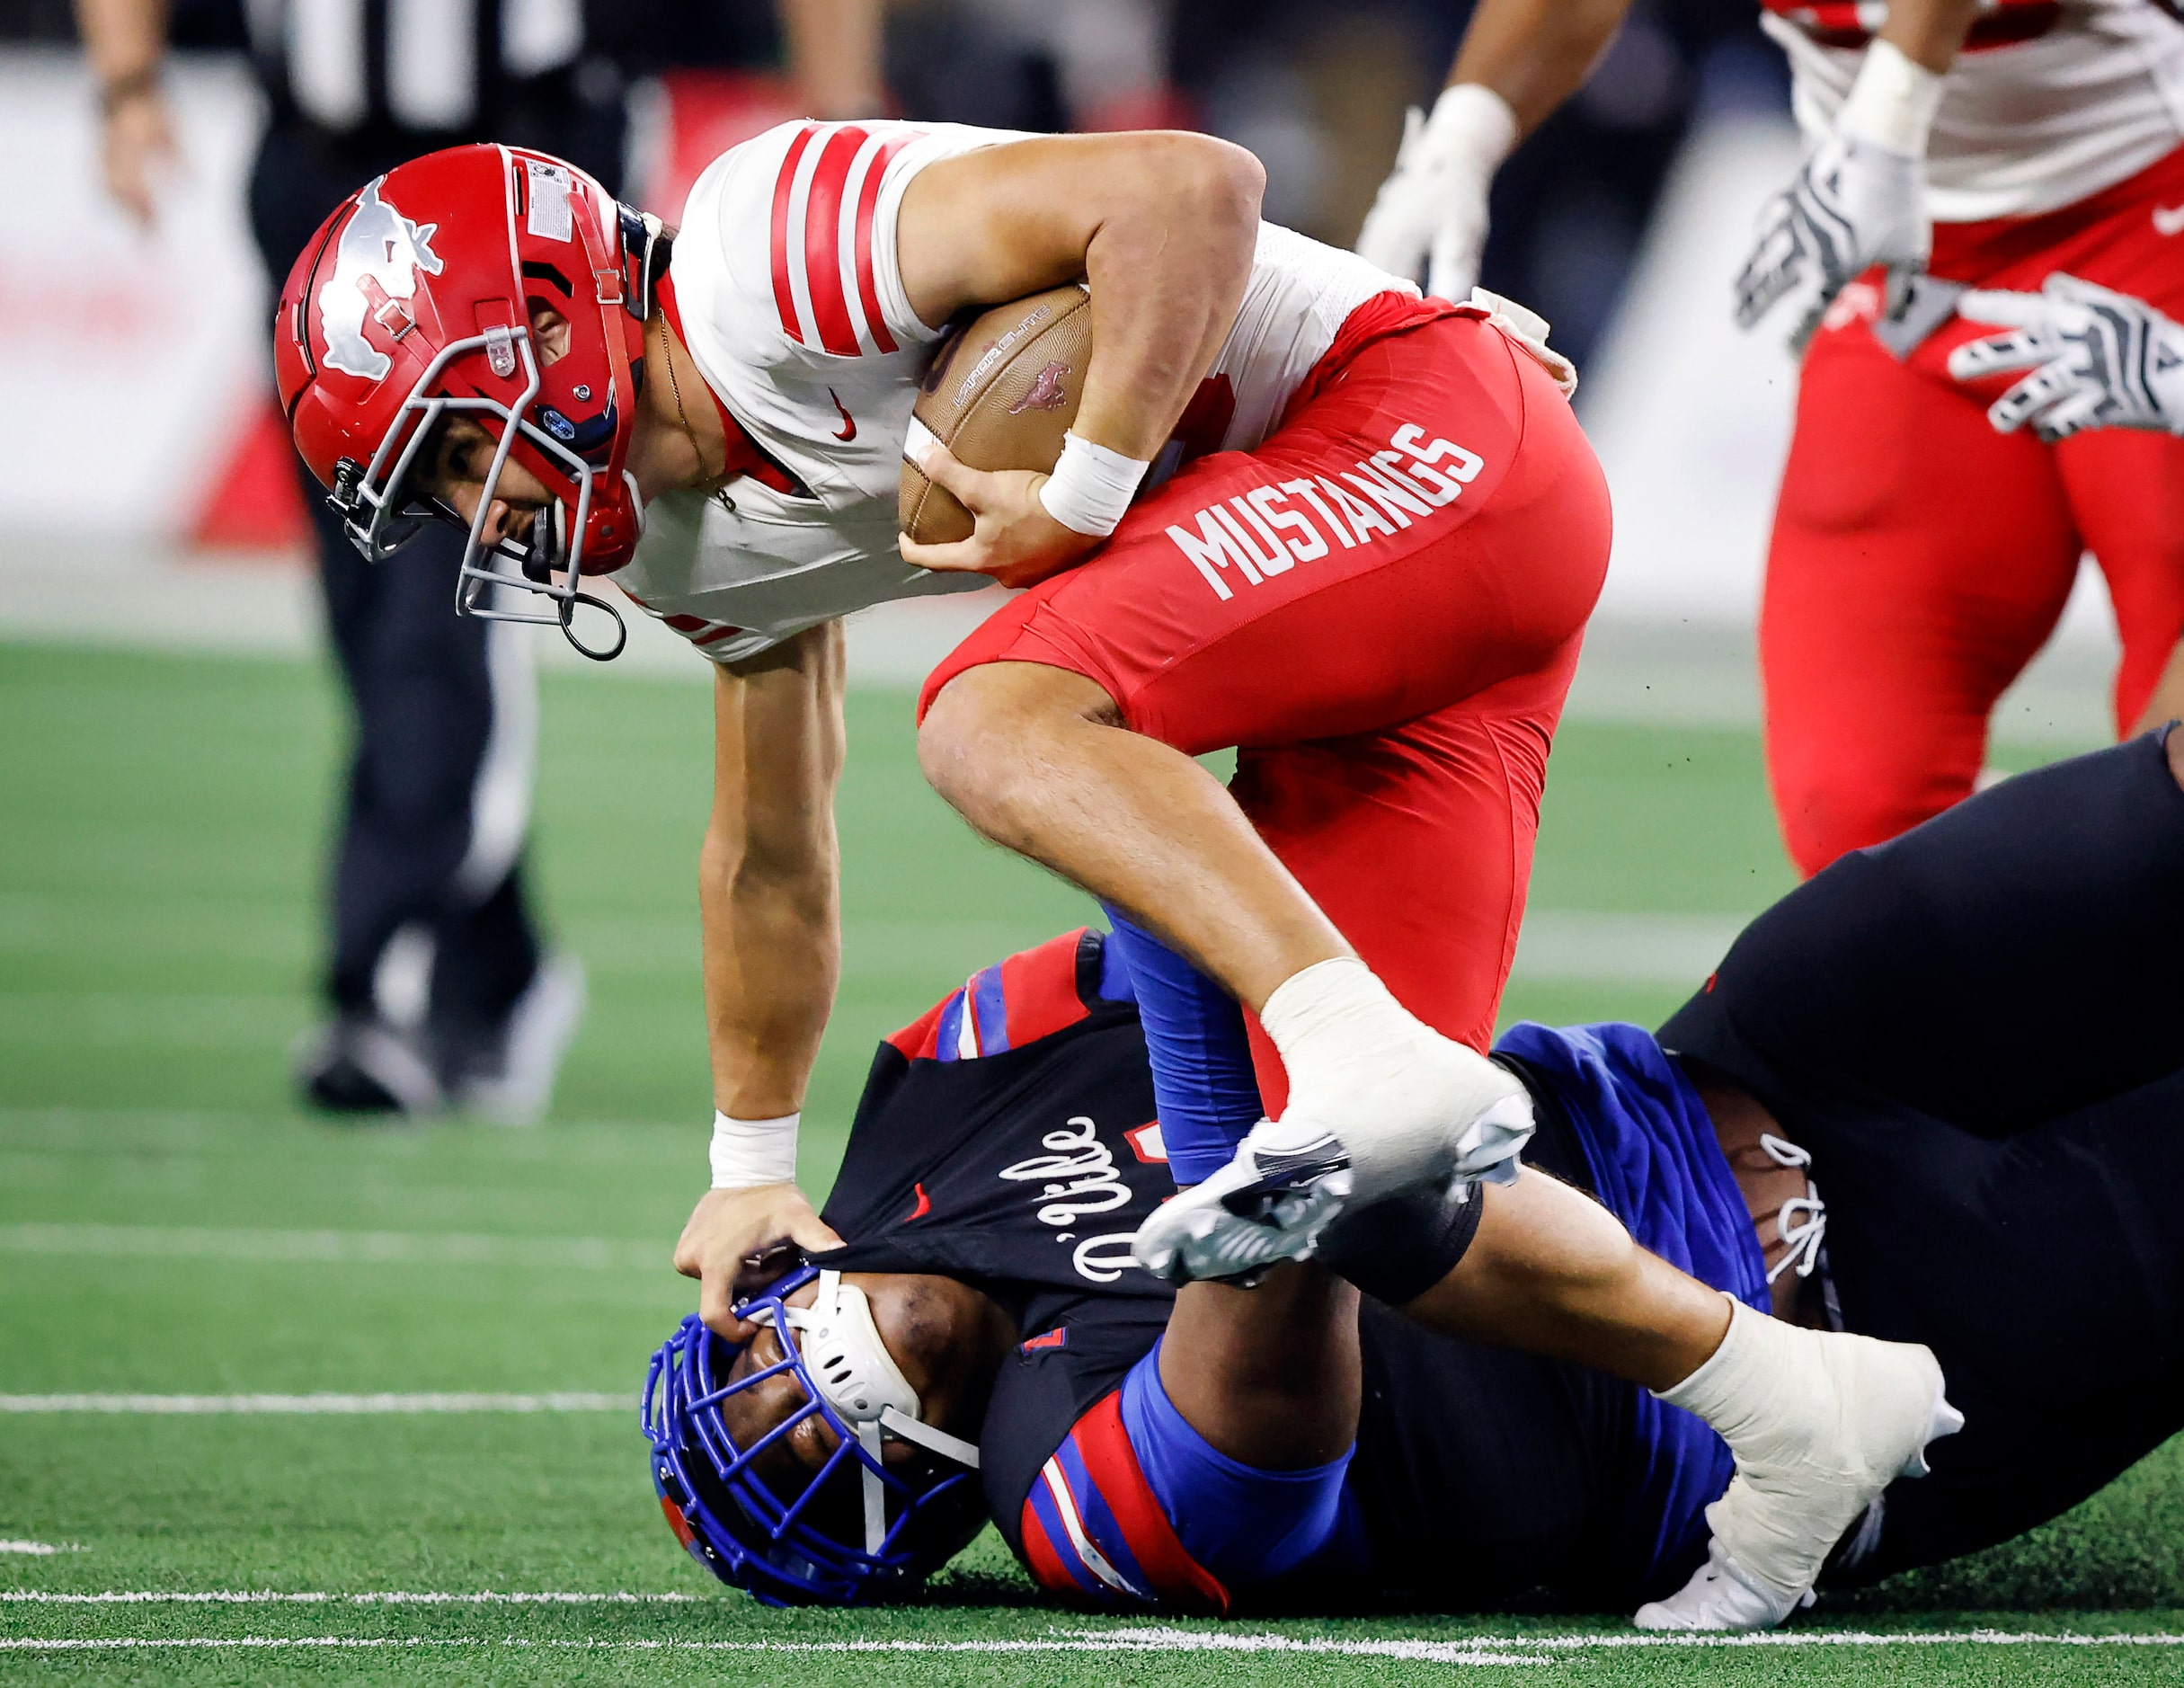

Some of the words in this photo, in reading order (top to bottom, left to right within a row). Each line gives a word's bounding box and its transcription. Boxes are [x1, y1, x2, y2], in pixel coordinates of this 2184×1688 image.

[953, 347, 1002, 407] VAPOR
[998, 304, 1052, 351] ELITE
[1164, 422, 1485, 601] MUSTANGS
